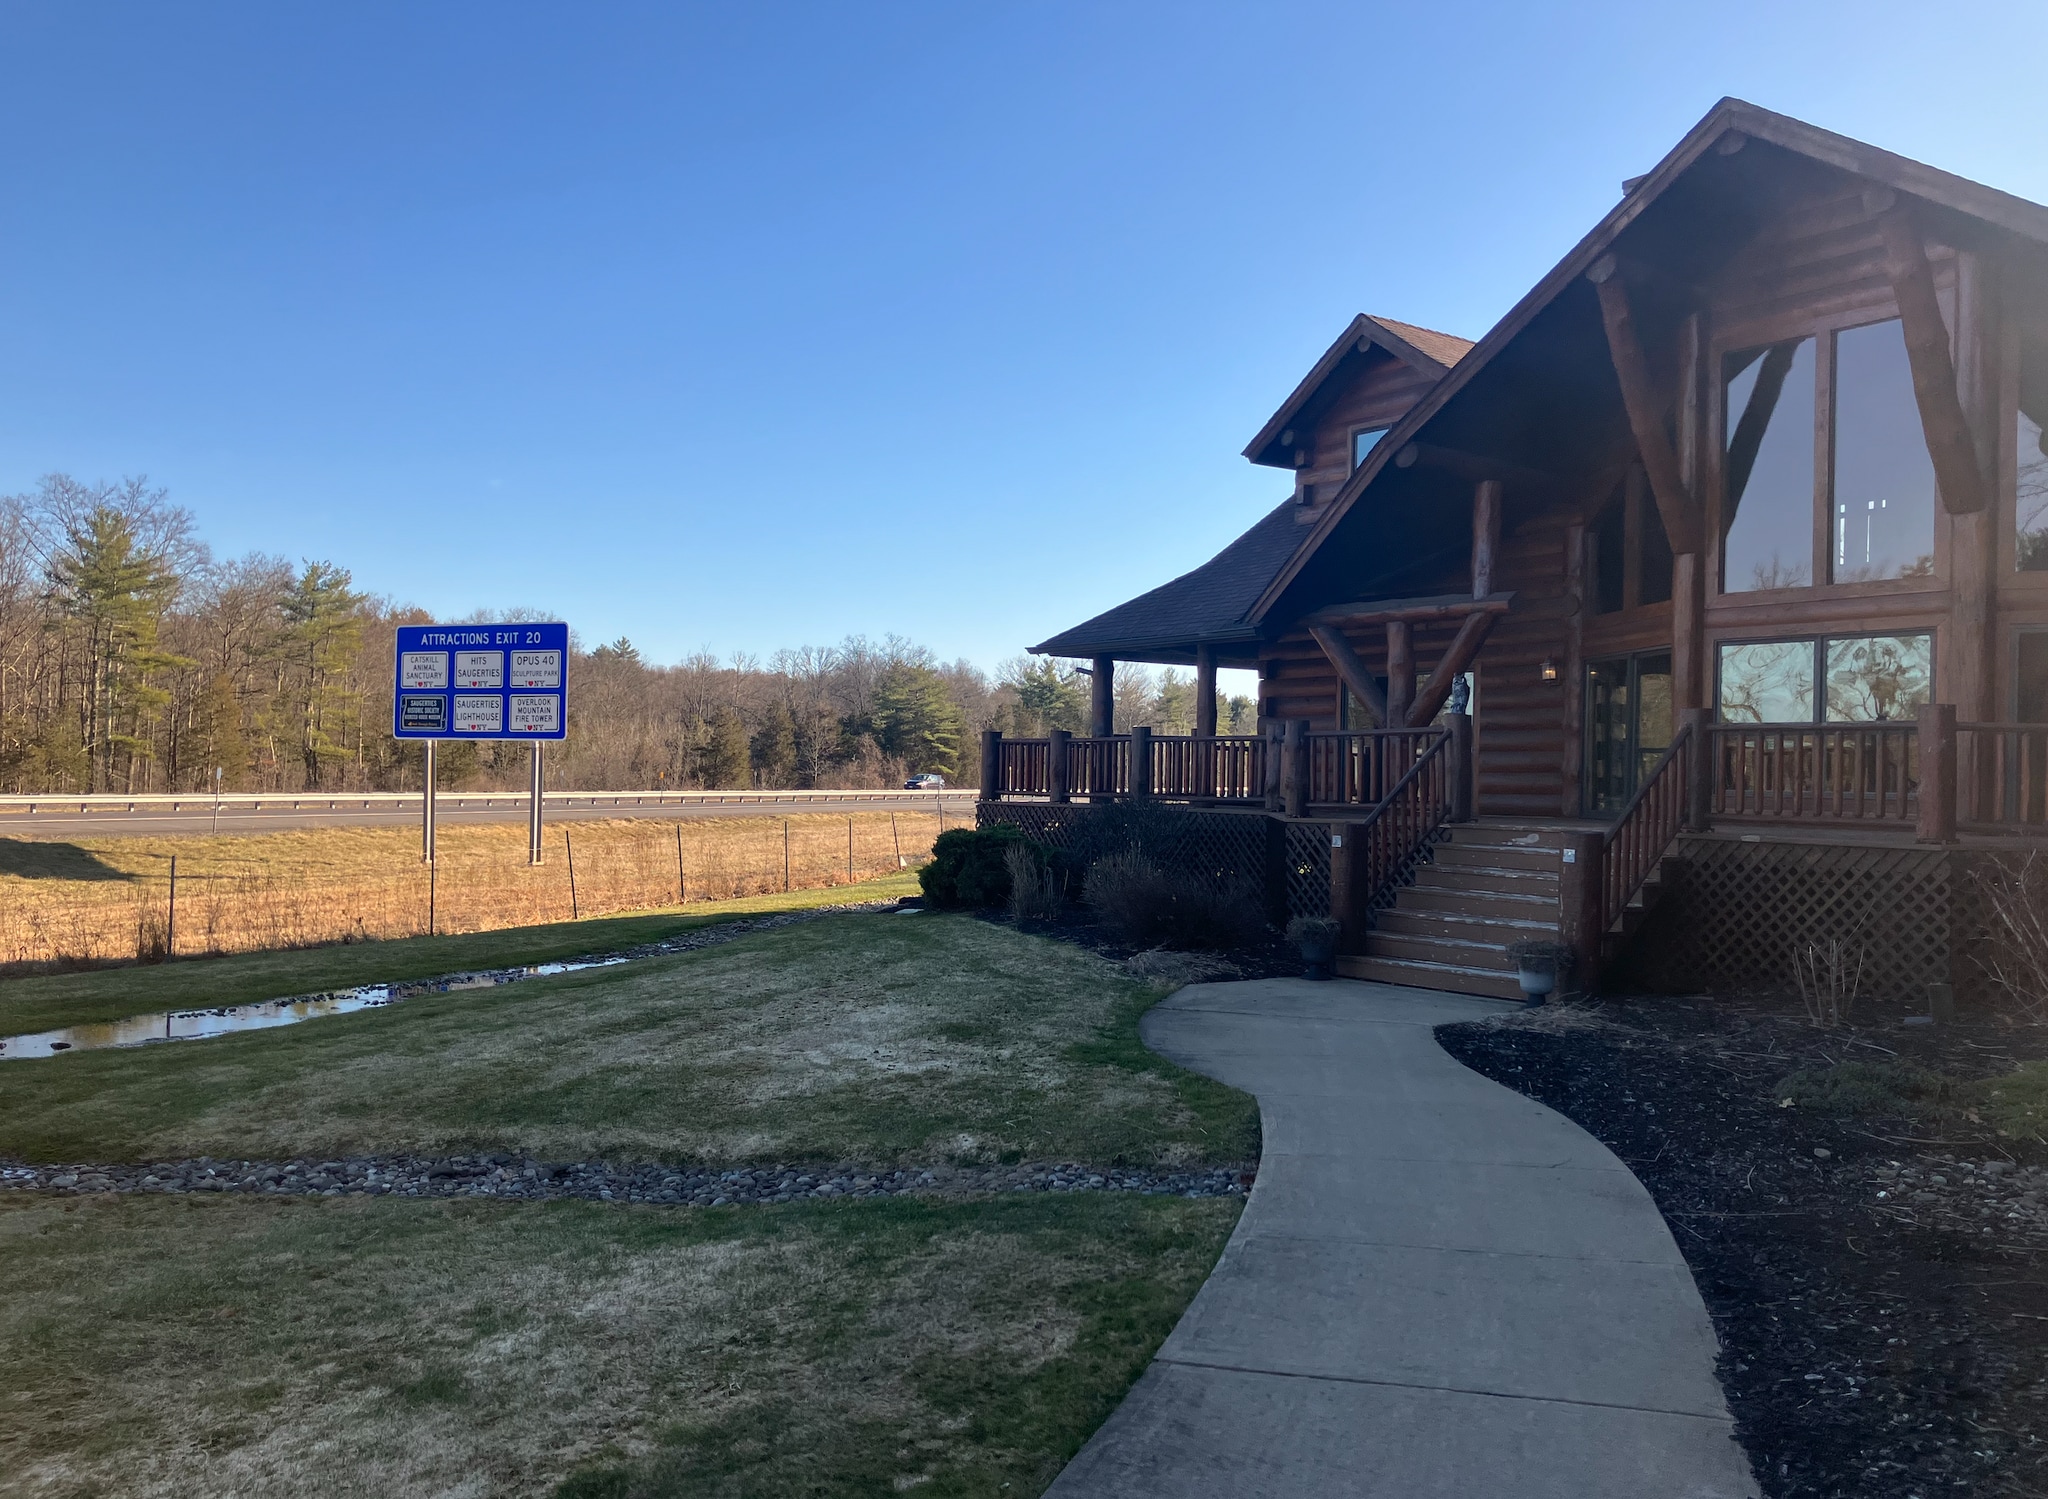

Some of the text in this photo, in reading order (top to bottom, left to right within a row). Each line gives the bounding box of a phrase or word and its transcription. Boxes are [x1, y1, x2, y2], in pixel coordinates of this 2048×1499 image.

[421, 632, 541, 646] ATTRACTIONS EXIT 20
[470, 657, 487, 665] HITS
[517, 656, 554, 665] OPUS 40
[458, 669, 500, 677] SAUGERTIES
[457, 700, 499, 709] SAUGERTIES
[517, 698, 551, 706] OVERLOOK
[456, 713, 499, 721] LIGHTHOUSE
